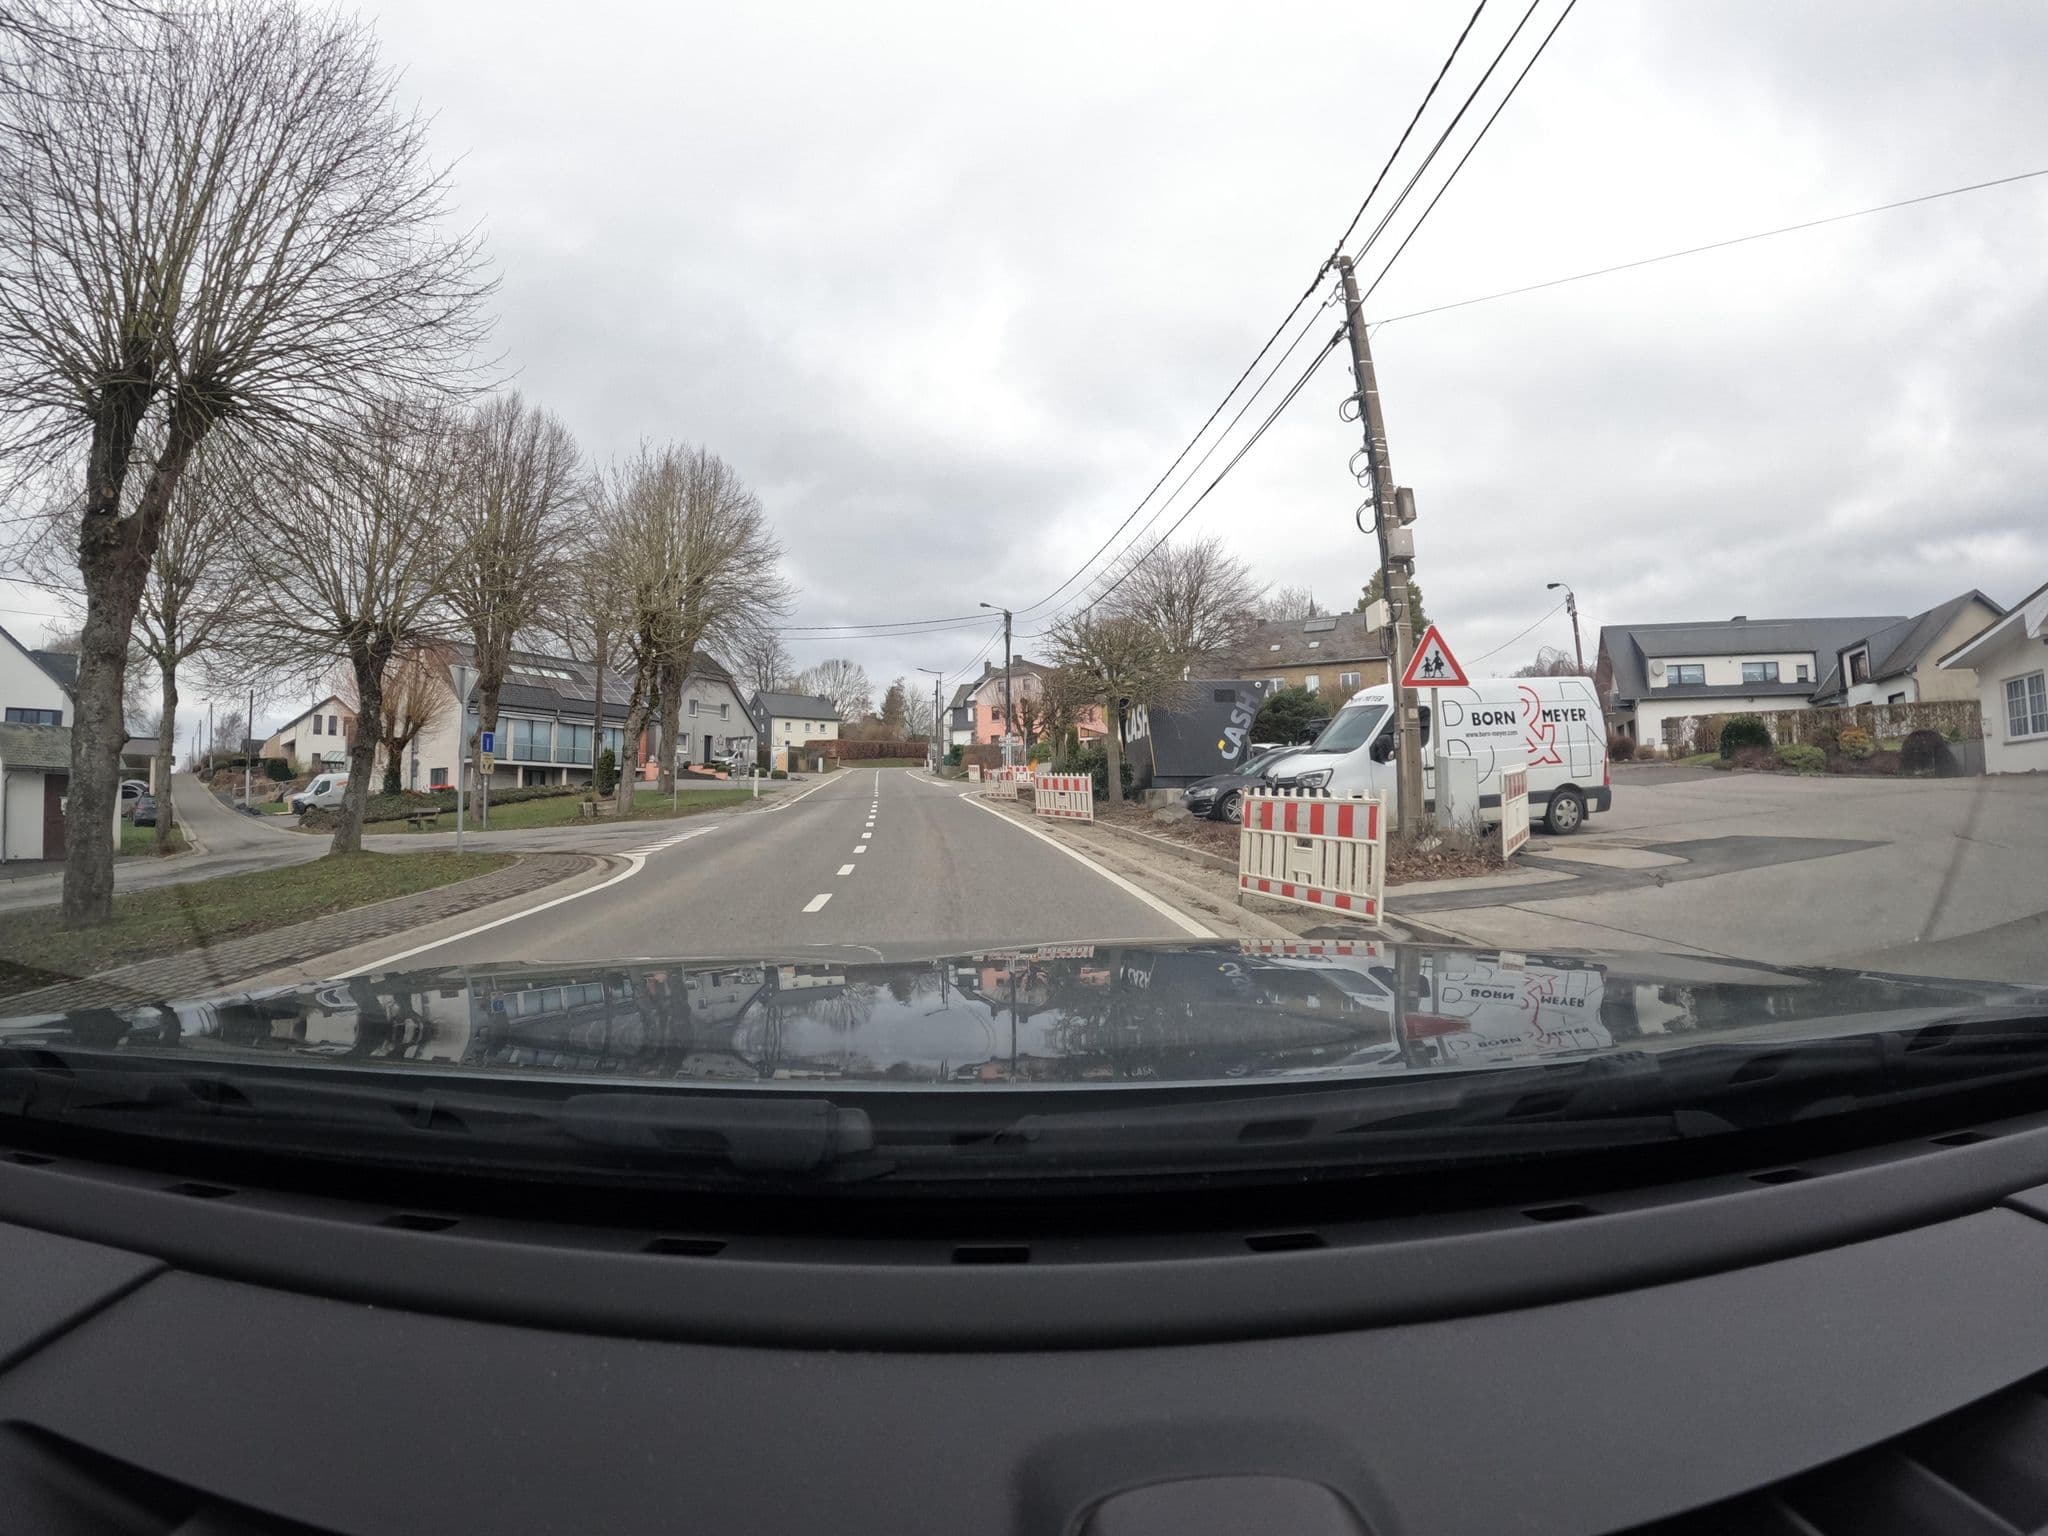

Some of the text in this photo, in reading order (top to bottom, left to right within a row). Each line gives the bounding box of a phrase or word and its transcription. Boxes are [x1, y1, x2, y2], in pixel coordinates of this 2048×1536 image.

[1218, 690, 1259, 760] CASH
[1471, 711, 1516, 726] BORN
[1542, 708, 1587, 722] MEYER
